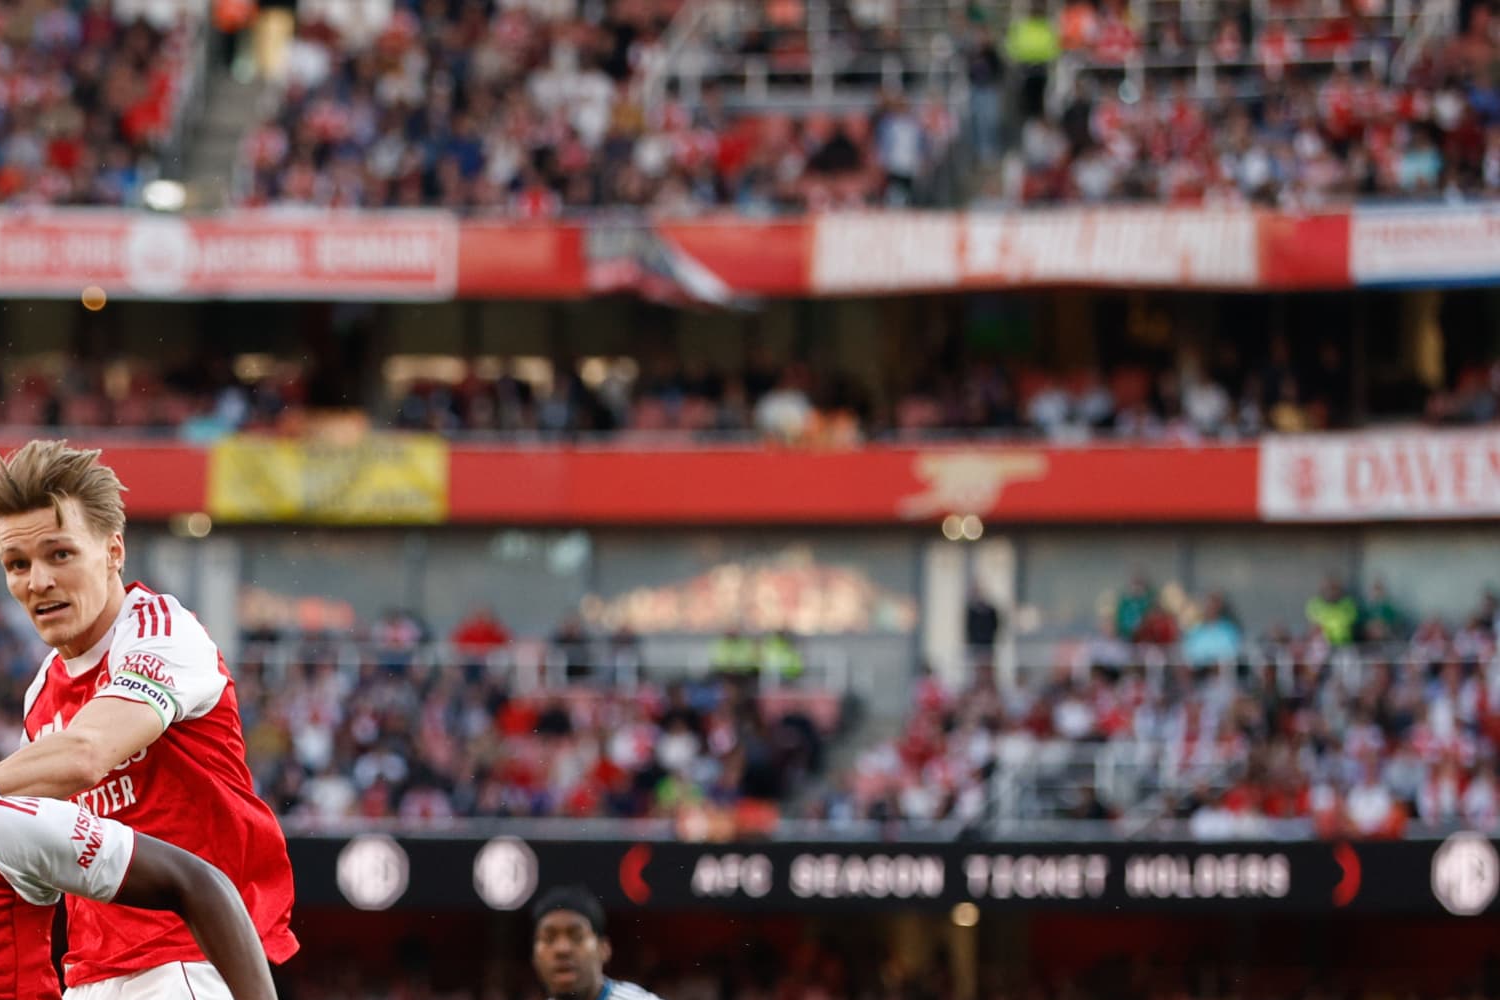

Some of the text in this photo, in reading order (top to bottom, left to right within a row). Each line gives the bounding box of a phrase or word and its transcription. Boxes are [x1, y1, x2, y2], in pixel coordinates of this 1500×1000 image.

[124, 653, 165, 673] VISIT
[113, 676, 169, 710] Captain
[691, 853, 1290, 898] AFC SEASON TICKET HOLDERS
